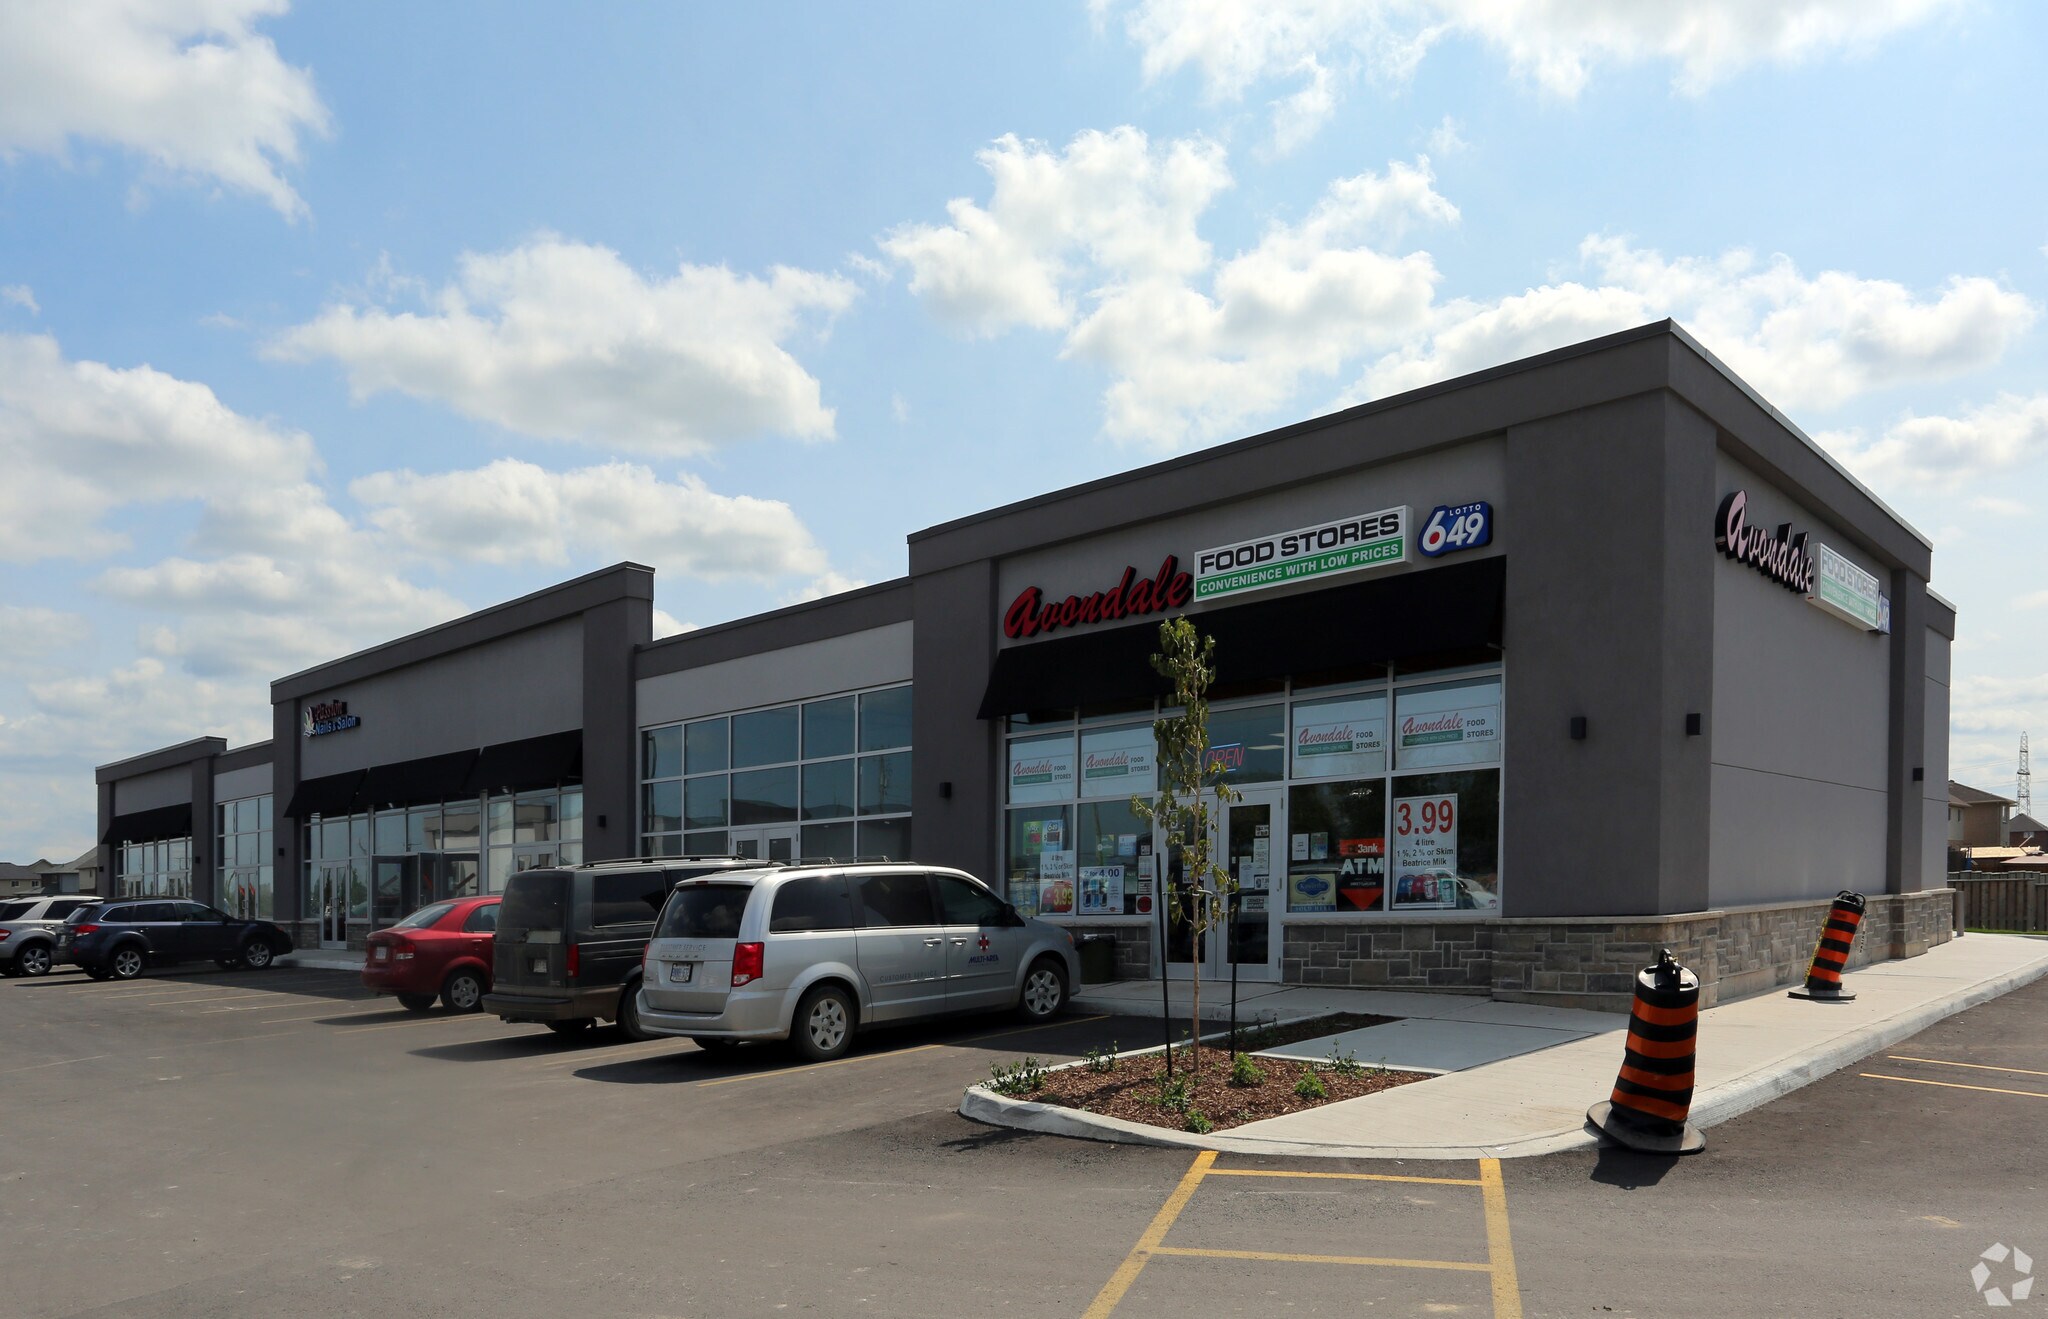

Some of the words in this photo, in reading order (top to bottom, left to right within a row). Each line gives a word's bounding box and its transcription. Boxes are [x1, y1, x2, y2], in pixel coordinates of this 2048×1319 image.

[1450, 504, 1482, 516] LOTTO
[1422, 511, 1485, 552] 649
[1200, 541, 1274, 575] FOOD
[1281, 513, 1400, 557] STORES
[1719, 490, 1814, 593] Avondale
[1200, 567, 1283, 594] CONVENIENCE
[1286, 561, 1317, 577] WITH
[1321, 554, 1348, 570] LOW
[1352, 544, 1399, 563] PRICES
[1822, 549, 1846, 583] FOOD
[1847, 565, 1877, 600] STORES
[1004, 554, 1193, 639] Avondale
[315, 720, 332, 735] Nails
[337, 716, 356, 730] Salon
[1403, 712, 1463, 734] Avondale
[1466, 719, 1486, 727] FOOD
[1299, 724, 1353, 744] Avondale
[1356, 731, 1374, 739] FOOD
[1467, 729, 1494, 738] STORES
[1356, 741, 1381, 750] STORES
[1086, 751, 1128, 768] Avondale
[1204, 746, 1244, 769] OPEN
[1013, 760, 1053, 776] Avondale
[1054, 773, 1071, 781] STORES
[1397, 800, 1454, 836] 3.99
[1422, 838, 1435, 846] litre
[1412, 849, 1417, 857] 2
[1436, 847, 1454, 856] Skim
[1340, 857, 1384, 875] ATM
[1402, 859, 1431, 867] Beatrice
[1433, 857, 1447, 866] Milk
[1099, 868, 1120, 878] 4.00
[1053, 887, 1073, 906] 3.99
[880, 972, 911, 982] CUSTOMER
[913, 970, 937, 978] SERVICE
